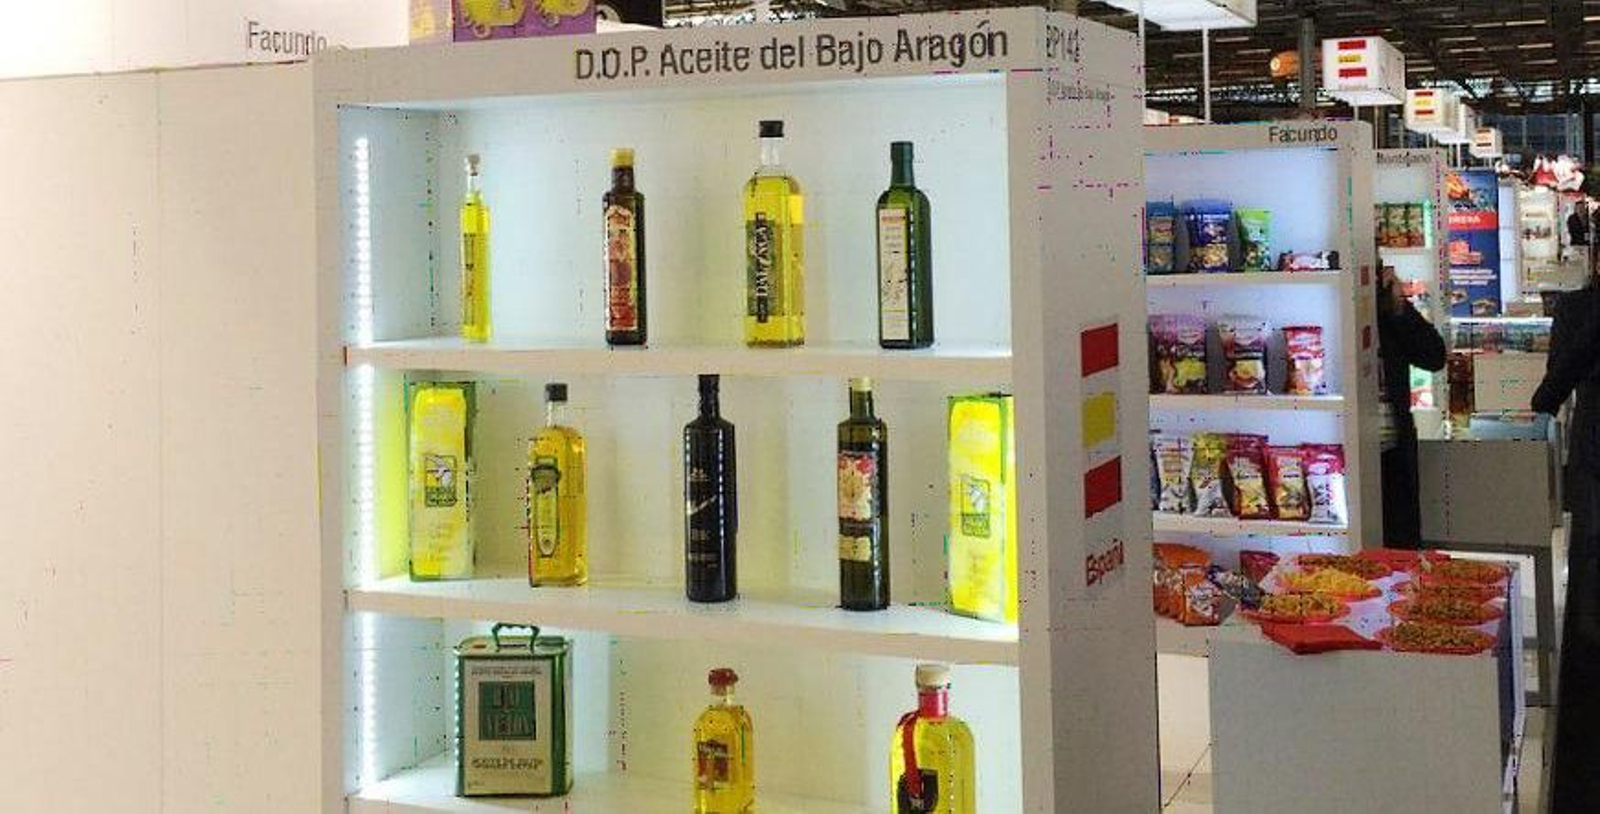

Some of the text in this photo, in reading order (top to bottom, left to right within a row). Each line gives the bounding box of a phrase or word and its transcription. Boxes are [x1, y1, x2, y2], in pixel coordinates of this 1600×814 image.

[576, 19, 1009, 80] D.O.P. Aceite del Bajo Aragón
[1268, 124, 1338, 143] Facundo
